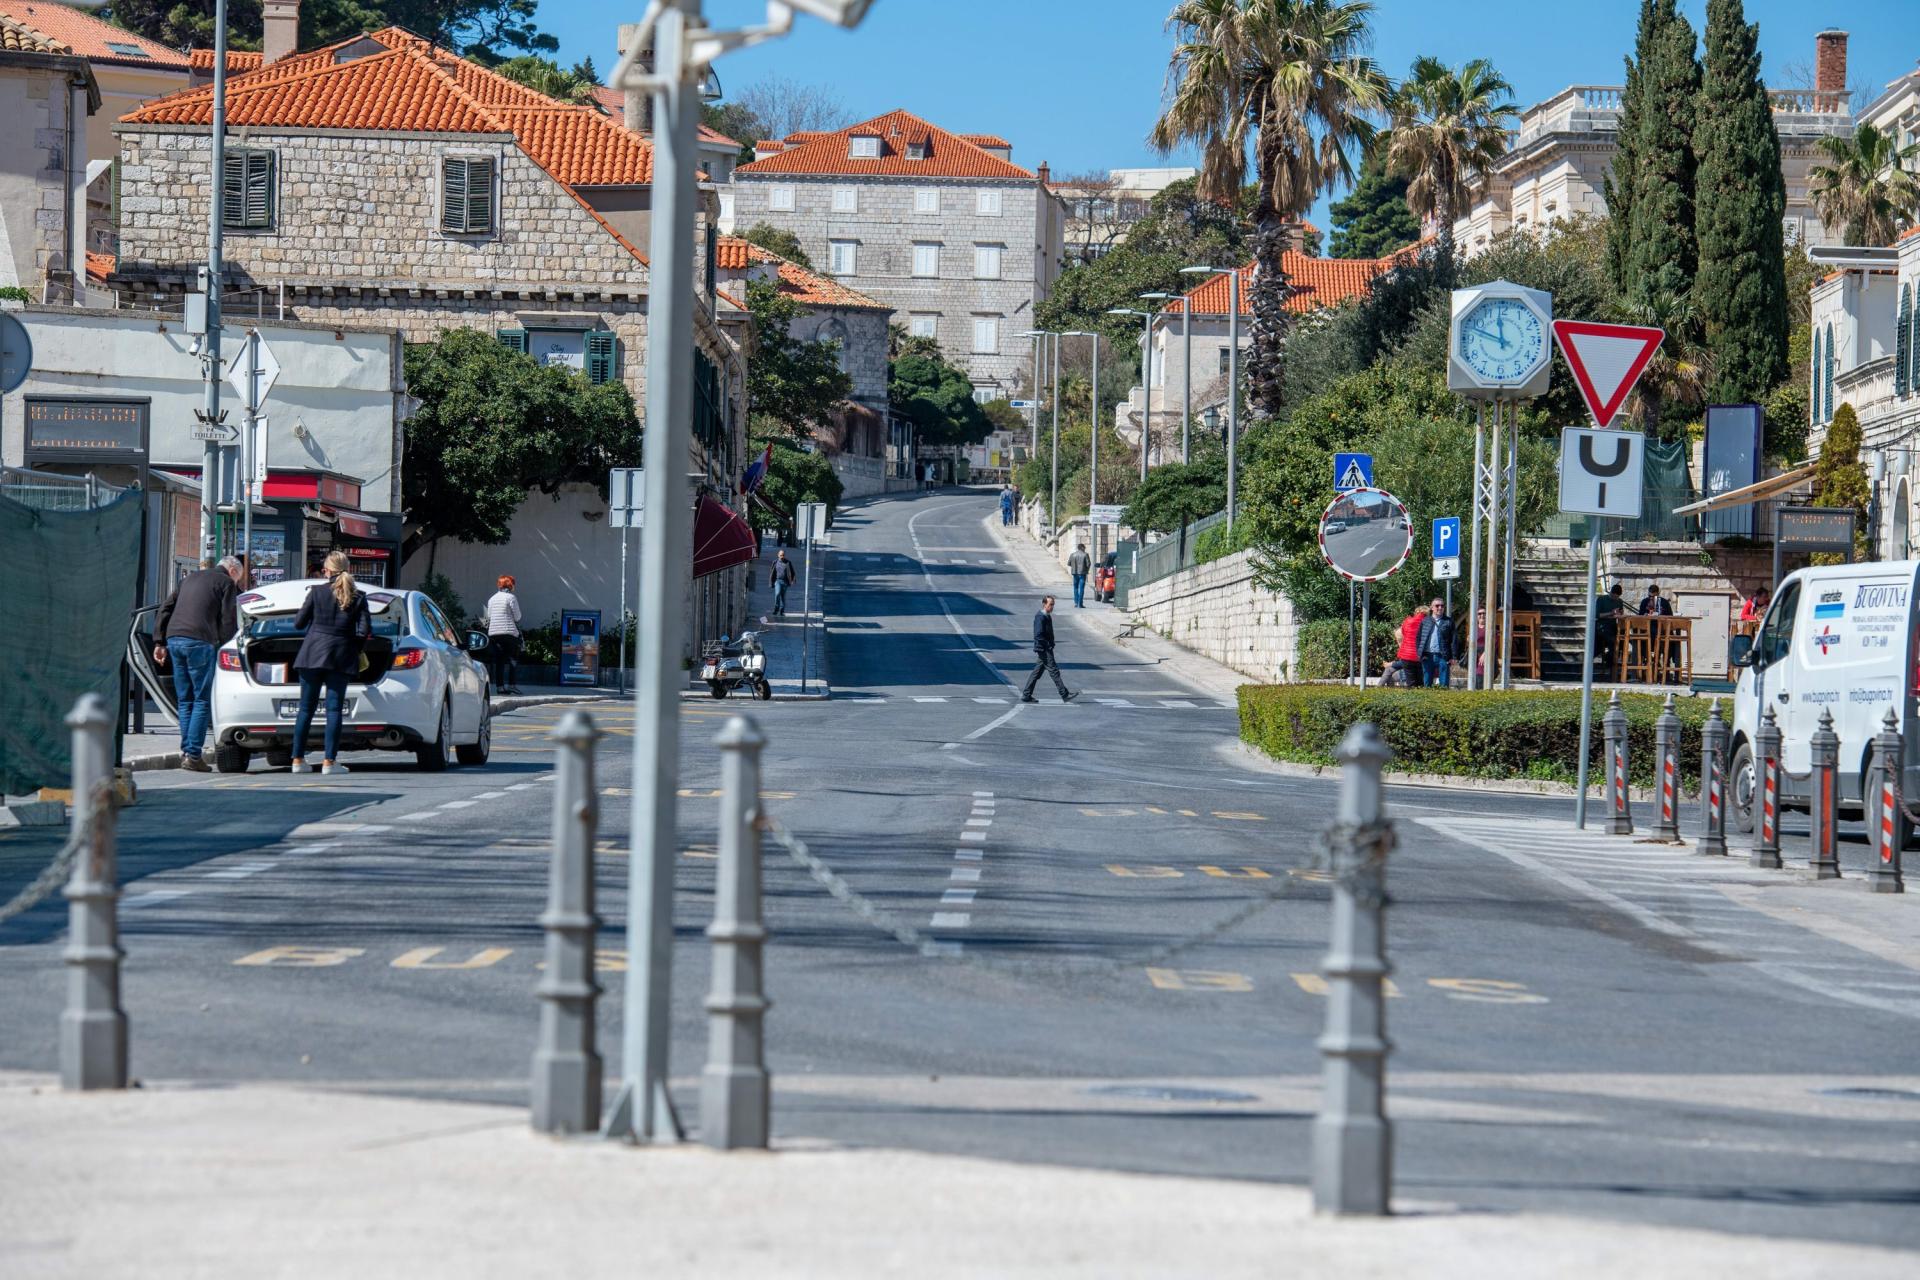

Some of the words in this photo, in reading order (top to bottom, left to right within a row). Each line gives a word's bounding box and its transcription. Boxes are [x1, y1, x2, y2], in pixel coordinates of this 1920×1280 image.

[1484, 309, 1493, 318] 11
[1473, 319, 1485, 329] 10
[1526, 320, 1533, 331] 2
[1468, 334, 1475, 344] 9
[1529, 336, 1536, 346] 3
[1471, 350, 1479, 360] 8
[1523, 350, 1531, 360] 4
[1481, 361, 1488, 371] 7
[1497, 364, 1505, 375] 6
[1514, 361, 1521, 371] 5
[1440, 525, 1452, 550] P
[1854, 585, 1908, 609] BUGOVINA
